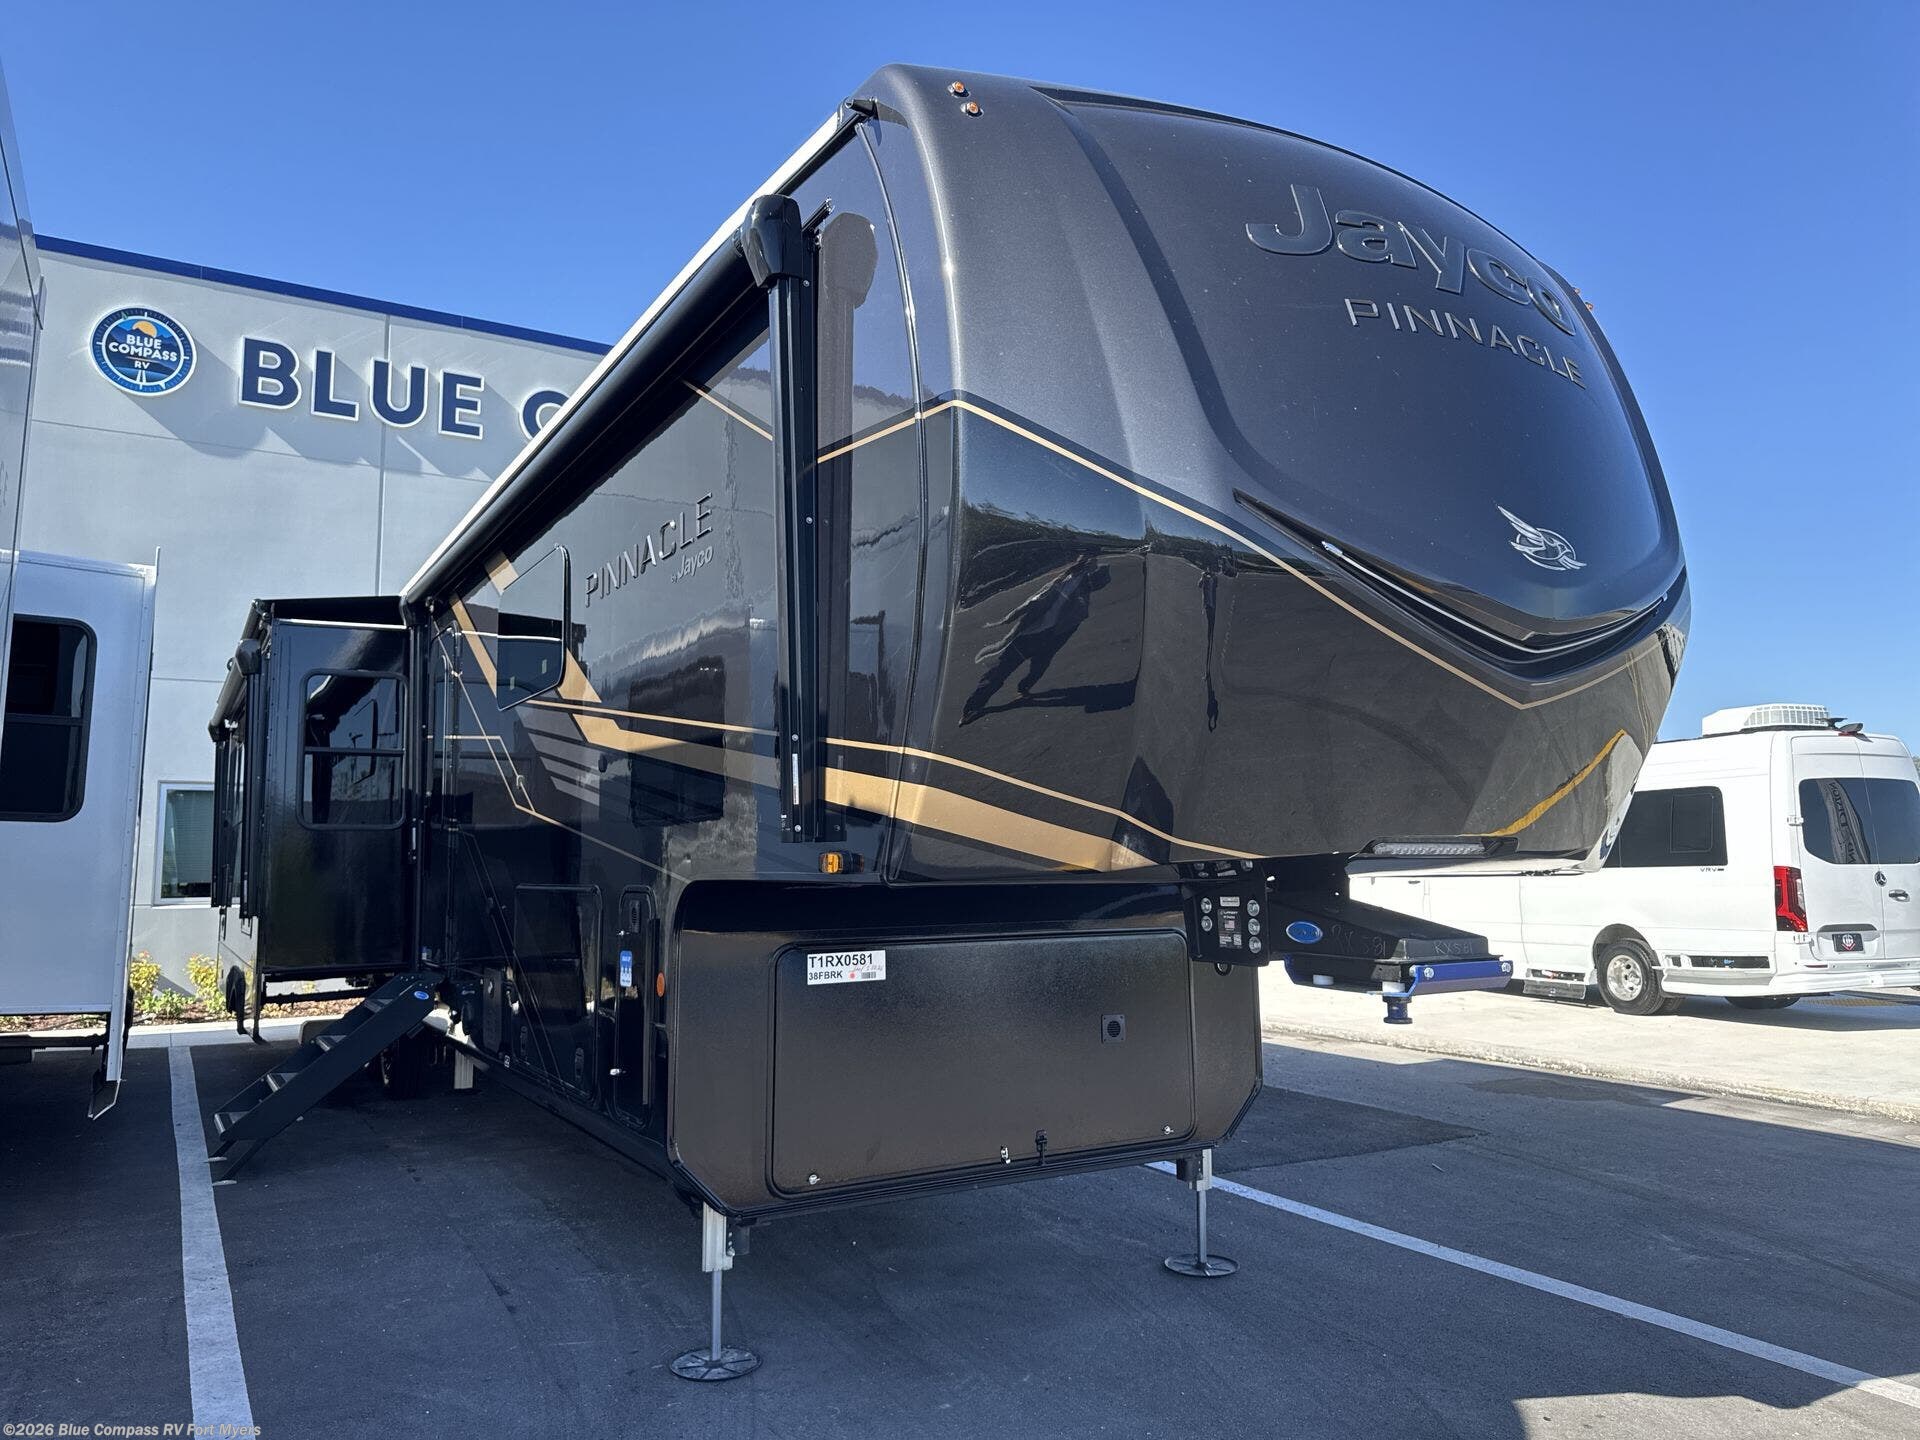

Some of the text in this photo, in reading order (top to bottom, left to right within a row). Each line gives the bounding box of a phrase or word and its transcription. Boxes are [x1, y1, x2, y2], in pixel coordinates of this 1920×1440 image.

[1245, 183, 1576, 336] Jayco
[108, 342, 178, 362] COMPASS
[126, 334, 162, 350] BLUE
[1344, 297, 1587, 390] PINNACLE
[134, 360, 151, 370] RV
[238, 336, 485, 440] BLUE
[585, 491, 713, 608] PINNACLE
[677, 546, 714, 580] Jayco
[808, 953, 873, 968] T1RX0581
[808, 970, 843, 981] 38FBRK
